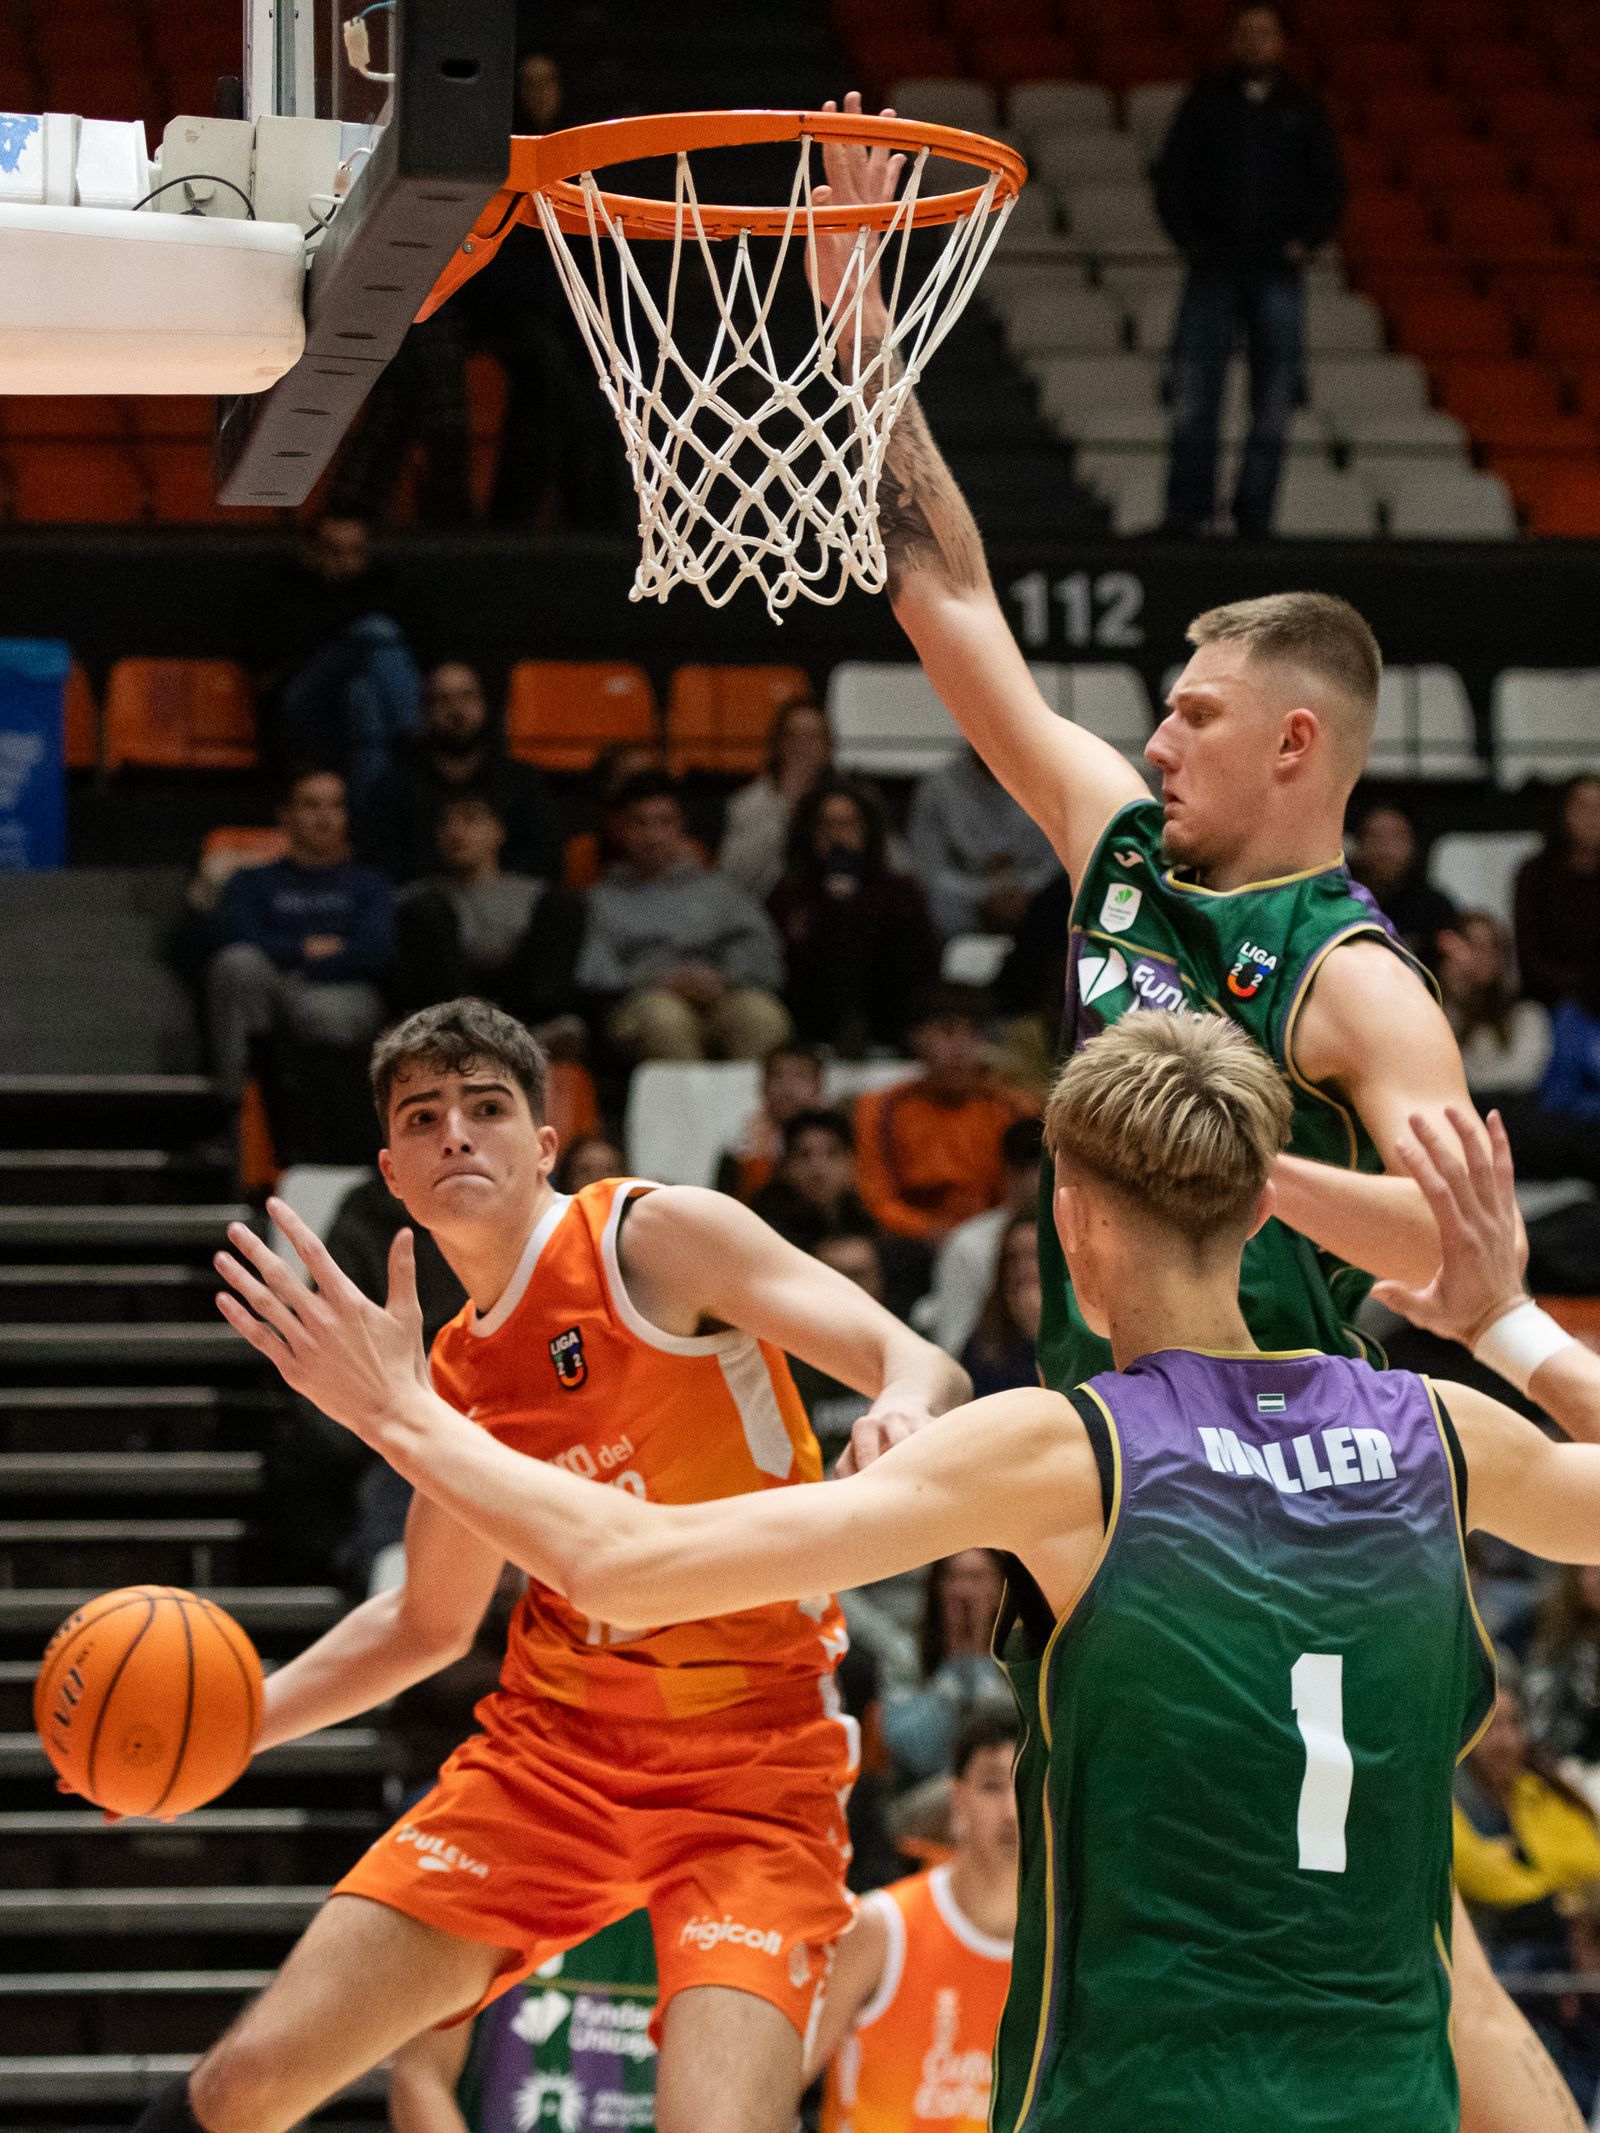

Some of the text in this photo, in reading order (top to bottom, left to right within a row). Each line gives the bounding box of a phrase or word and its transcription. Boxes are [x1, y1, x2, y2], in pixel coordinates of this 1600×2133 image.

[1009, 571, 1144, 645] 112
[1239, 941, 1278, 971] LIGA
[549, 1331, 580, 1356] LIGA
[1291, 1652, 1354, 1873] 1
